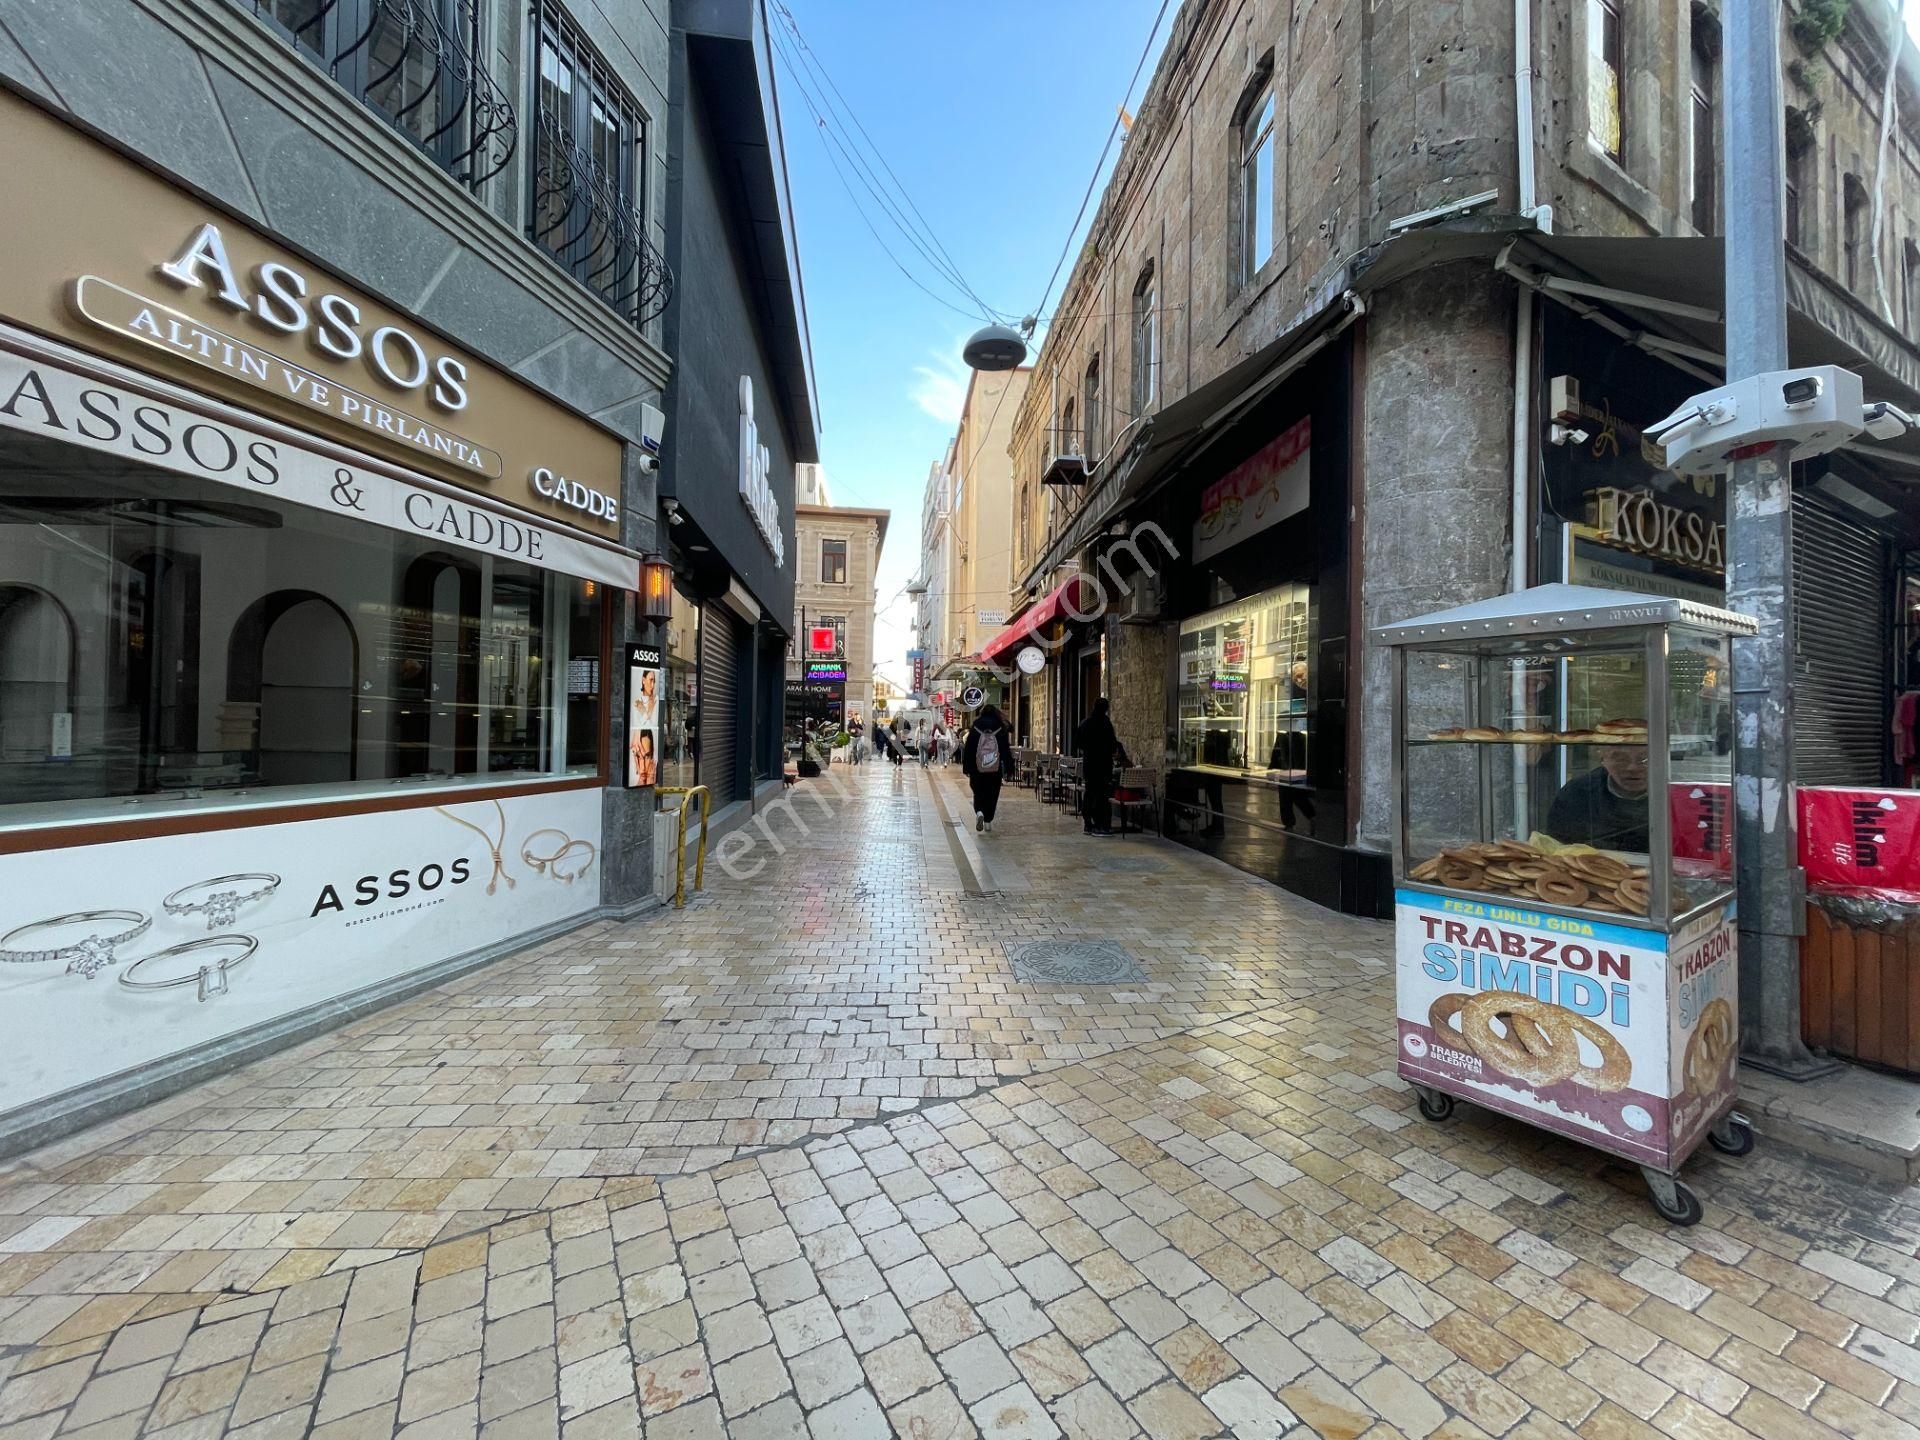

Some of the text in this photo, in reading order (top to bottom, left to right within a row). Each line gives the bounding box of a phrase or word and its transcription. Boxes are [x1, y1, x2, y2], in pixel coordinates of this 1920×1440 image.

[160, 222, 470, 412] ASSOS
[128, 306, 485, 469] ALTIN VE PIRLANTA
[3, 369, 546, 564] ASSOS & CADDE
[533, 466, 618, 524] CADDE
[633, 649, 659, 663] ASSOS
[810, 663, 842, 671] AKBANK
[1831, 842, 1853, 866] life
[310, 857, 470, 918] ASSOS
[345, 898, 445, 928] assosdiamond.com
[1443, 899, 1595, 937] FEZA UNLU GIDA
[1419, 915, 1632, 982] TRABZON
[1430, 1043, 1482, 1068] TRABZON
